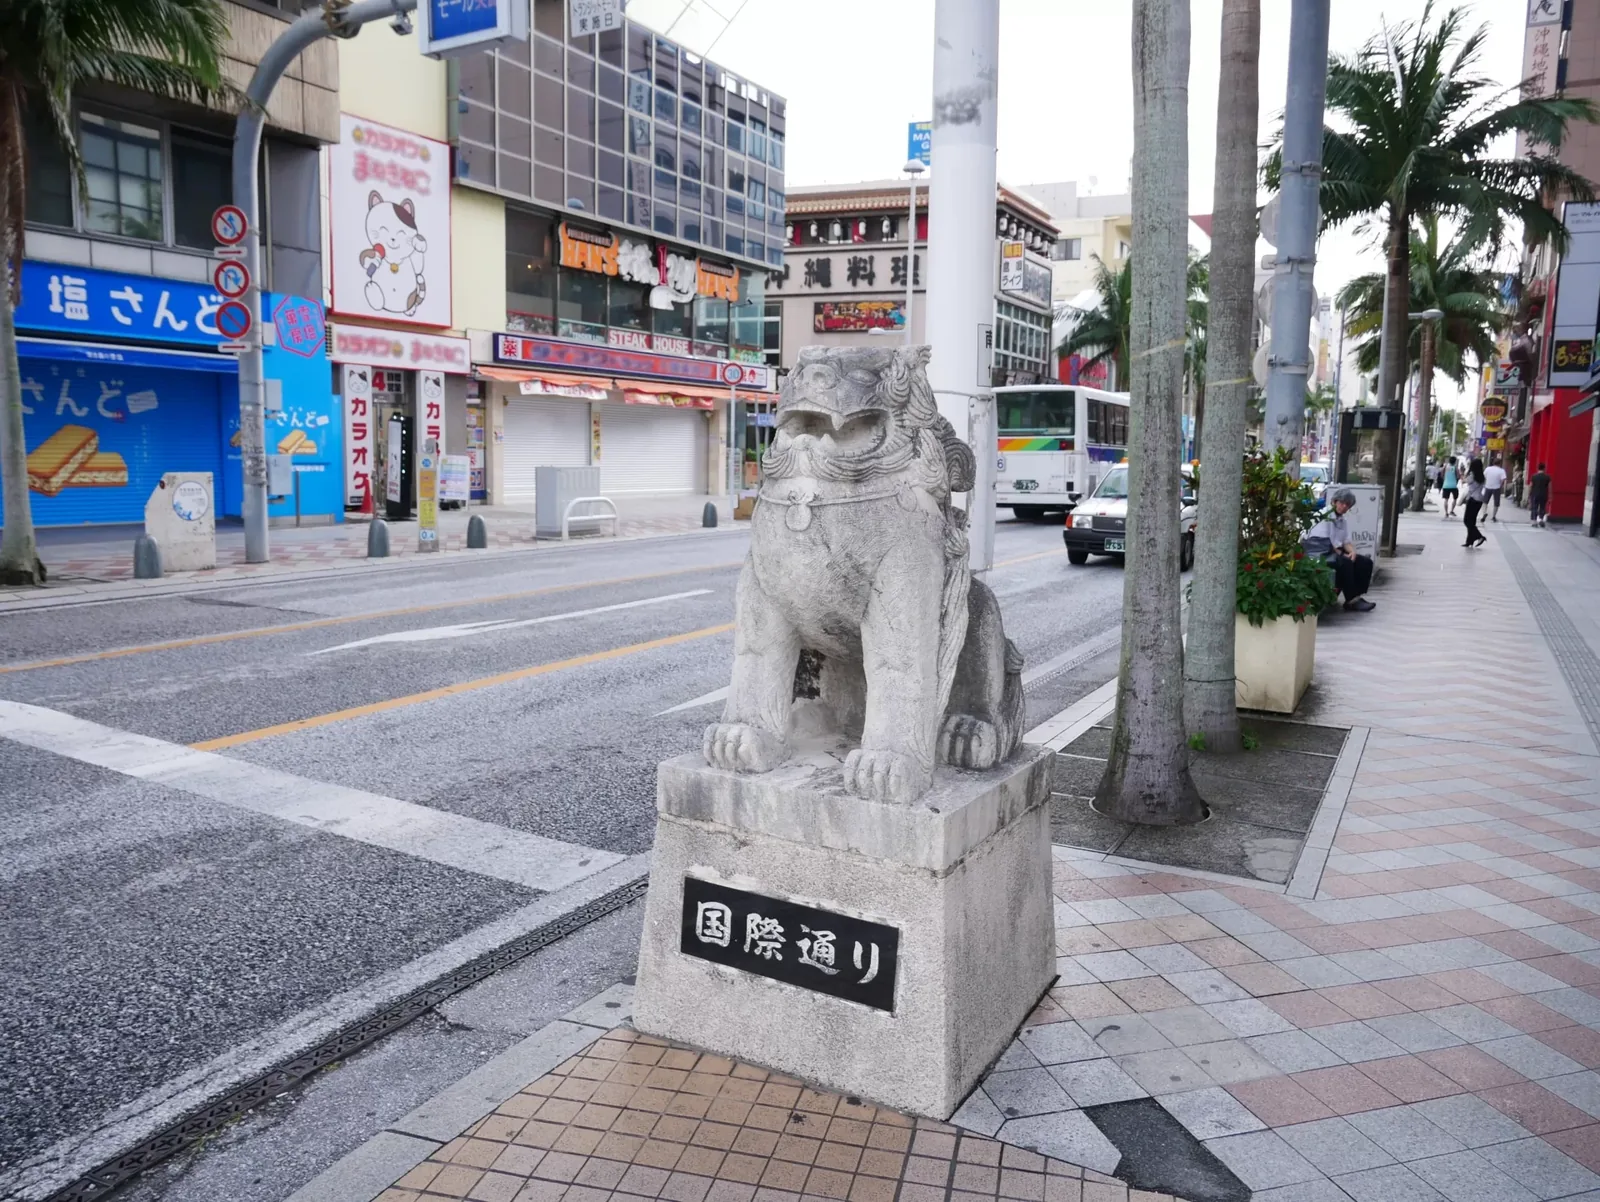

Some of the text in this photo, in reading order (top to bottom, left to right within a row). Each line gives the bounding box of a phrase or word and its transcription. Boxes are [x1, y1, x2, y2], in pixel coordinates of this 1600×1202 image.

[579, 12, 613, 32] 実施日
[48, 274, 225, 337] 塩さんど
[609, 330, 689, 355] STEAK HOUSE
[351, 397, 369, 490] カラオケ
[695, 901, 879, 984] 国際通り
